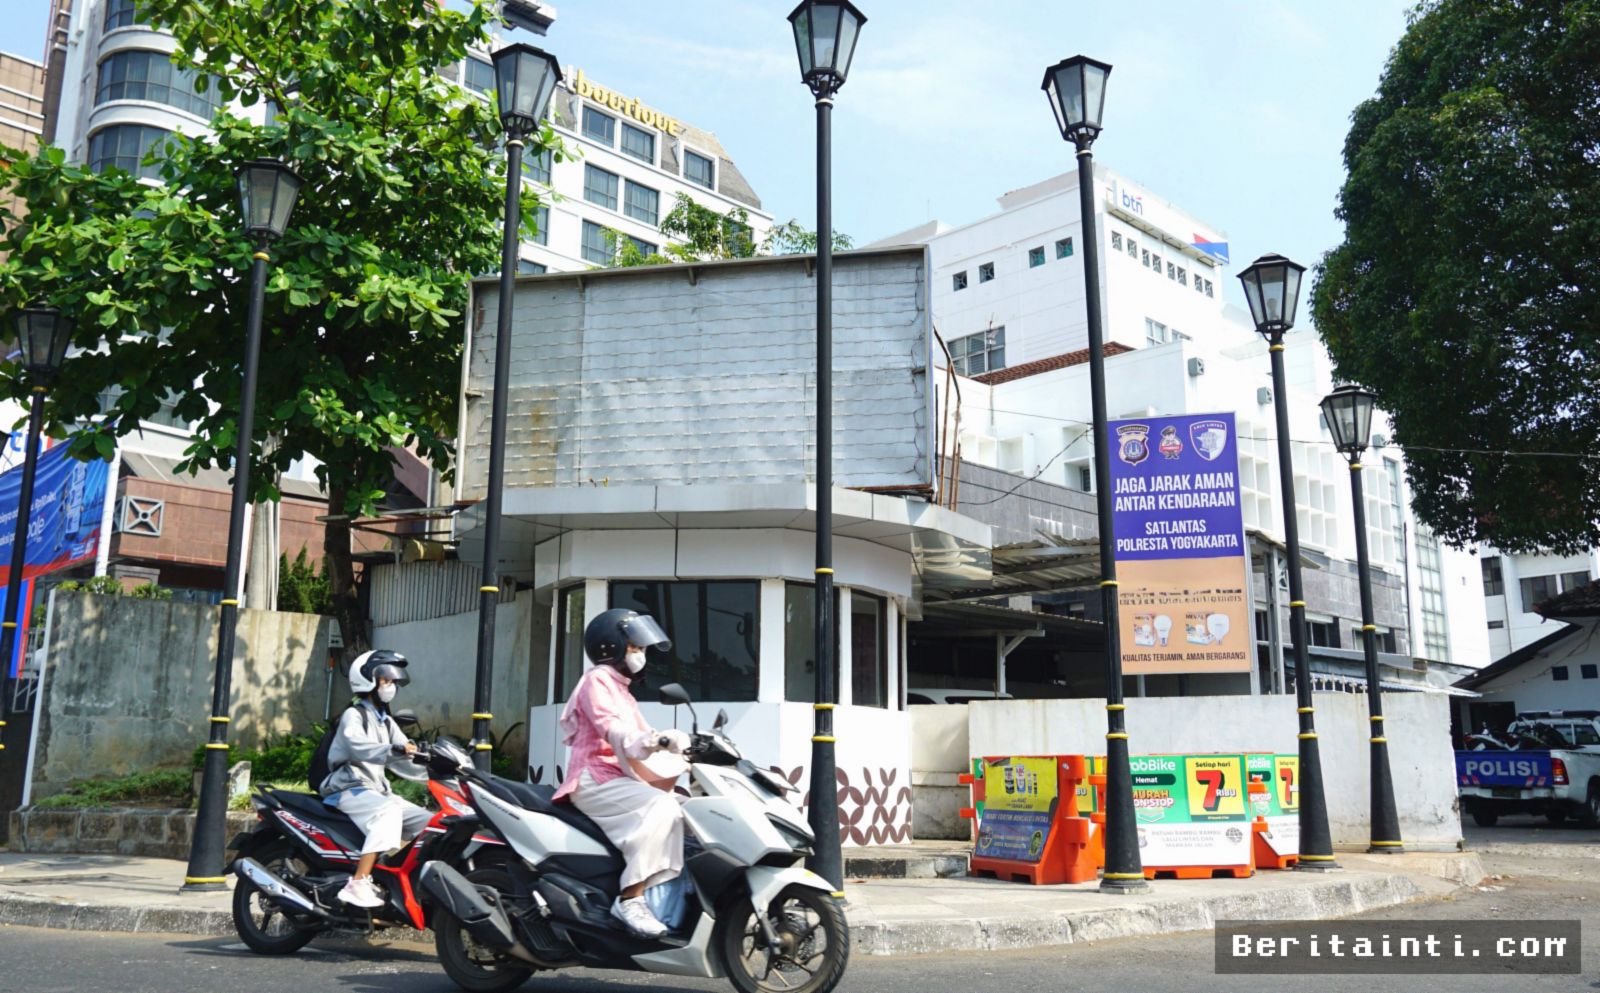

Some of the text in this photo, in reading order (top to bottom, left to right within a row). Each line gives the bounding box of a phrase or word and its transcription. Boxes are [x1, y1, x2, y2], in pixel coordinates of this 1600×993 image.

[1122, 188, 1143, 216] btn
[1114, 472, 1234, 494] JAGA JARAK AMAN
[1115, 491, 1235, 512] ANTAR KENDARAAN
[1145, 519, 1207, 535] SATLANTAS
[1117, 534, 1238, 552] POLRESTA YOGYAKARTA
[1122, 653, 1152, 662] KUALITAS
[1186, 652, 1205, 661] AMAN
[1206, 651, 1246, 660] BERGARANSI
[1129, 758, 1176, 771] abBike
[1195, 761, 1217, 769] Setiap
[1465, 760, 1539, 776] POLISI
[1135, 776, 1158, 784] Hemat
[1279, 768, 1294, 806] 7
[1132, 789, 1170, 799] MURAH
[1195, 769, 1225, 812] 7
[1215, 788, 1237, 797] RIBU
